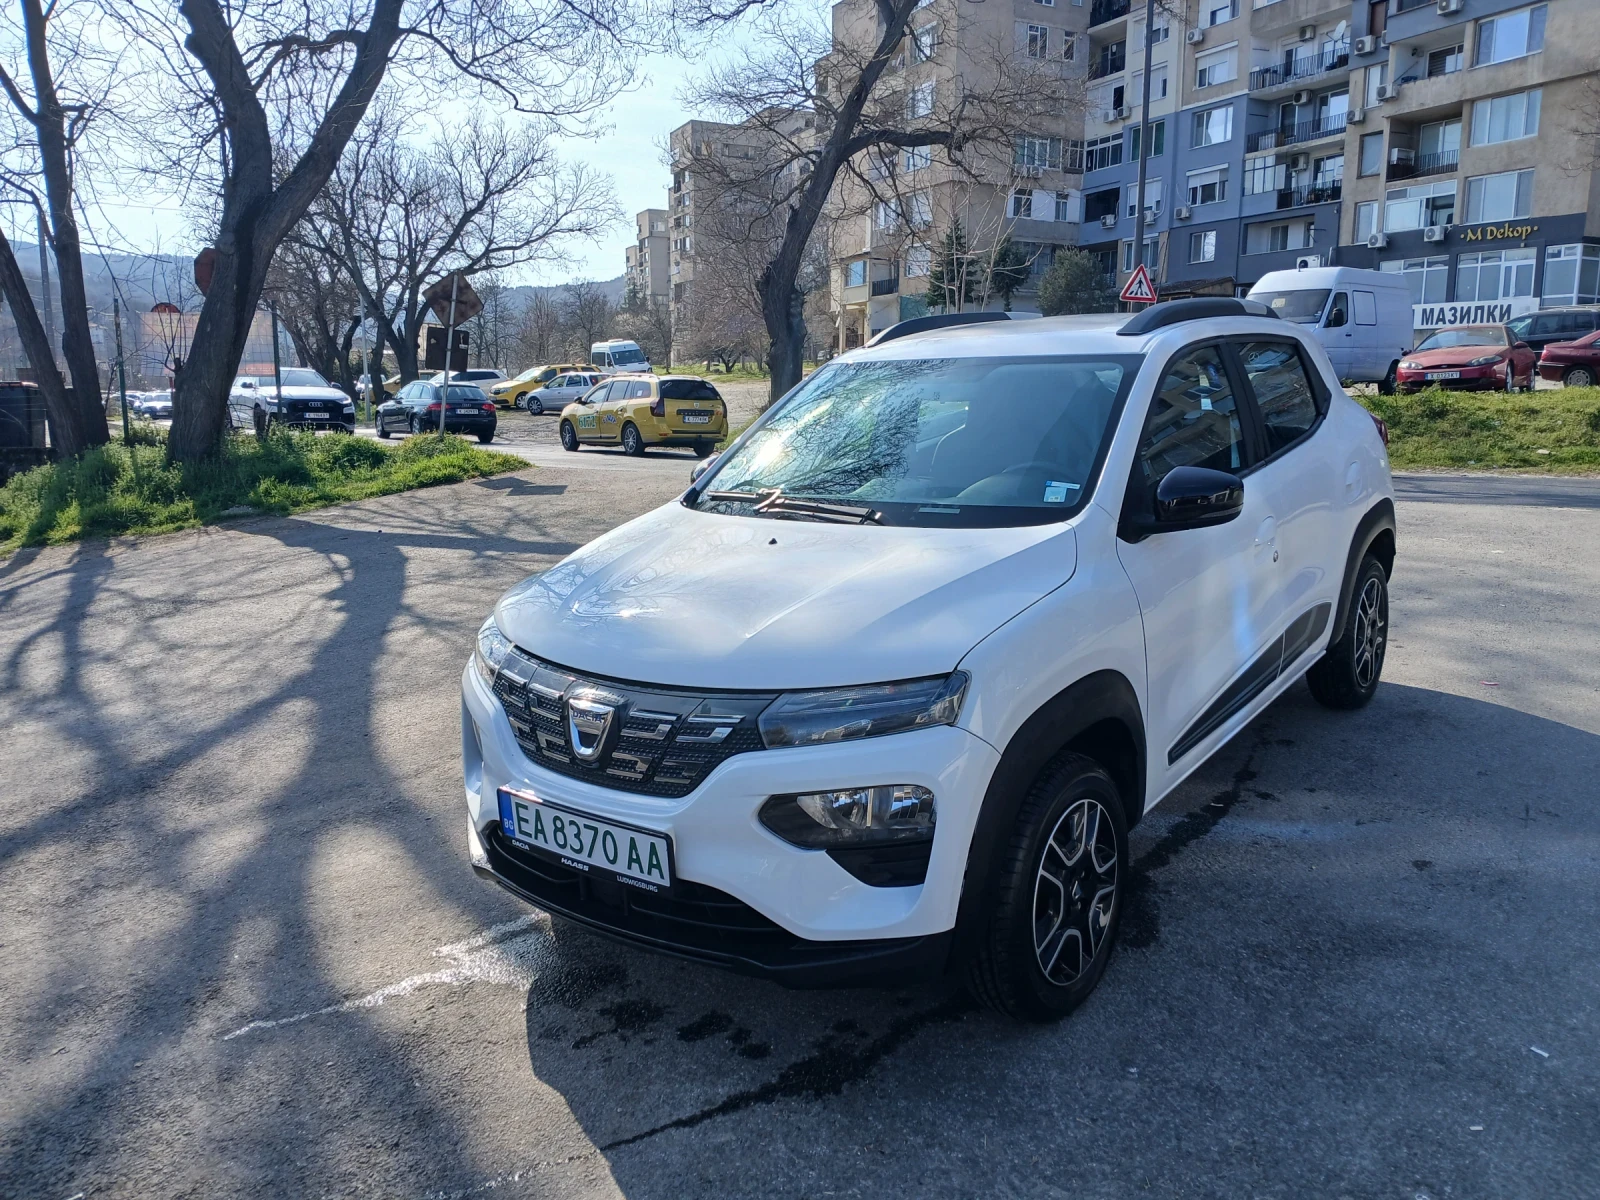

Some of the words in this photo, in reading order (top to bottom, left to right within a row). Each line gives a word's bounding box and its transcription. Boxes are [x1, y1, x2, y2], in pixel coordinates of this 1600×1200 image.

[1466, 226, 1483, 242] M
[1420, 304, 1512, 326] МАЗИЛКИ
[572, 709, 604, 723] DACIA
[503, 817, 514, 831] BG
[514, 801, 549, 845] EA
[552, 815, 619, 866] 8370
[626, 836, 665, 880] AA
[511, 839, 530, 851] DACIA
[560, 857, 590, 872] HAASS
[616, 875, 659, 893] LUDWIGSBURG
